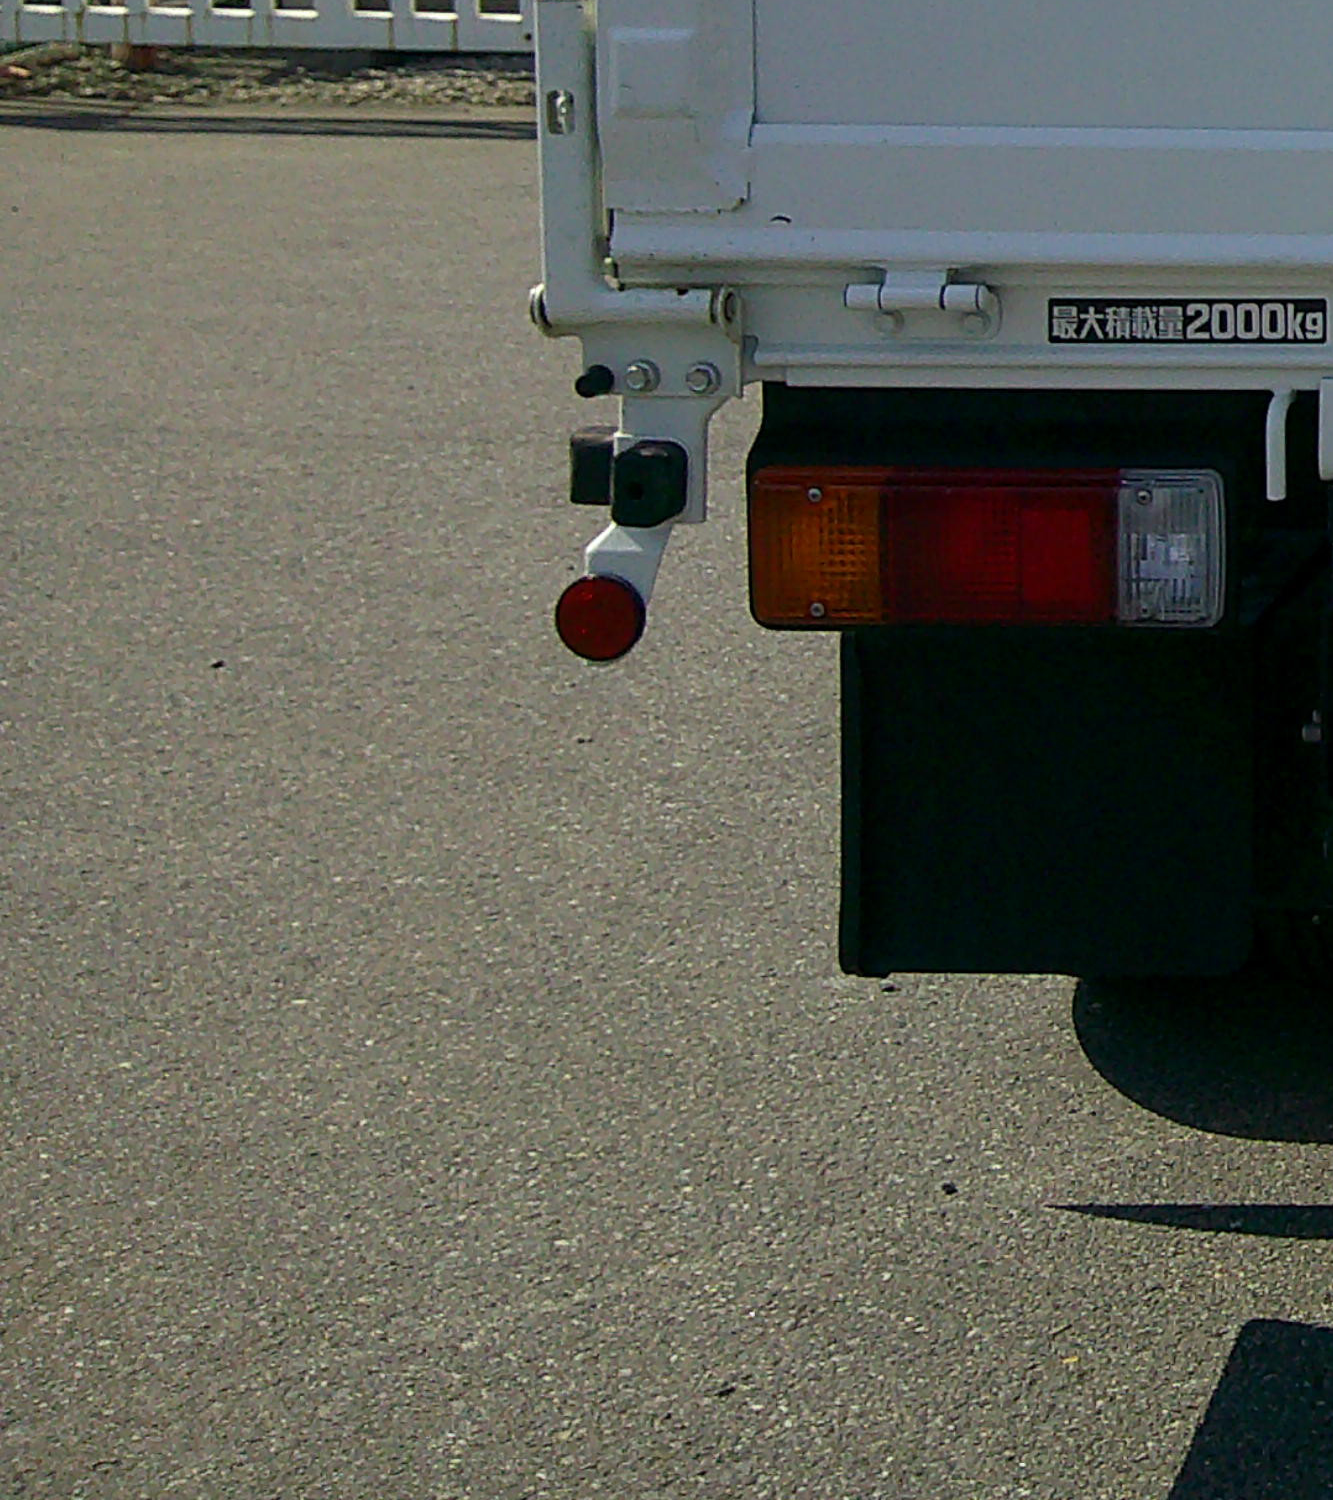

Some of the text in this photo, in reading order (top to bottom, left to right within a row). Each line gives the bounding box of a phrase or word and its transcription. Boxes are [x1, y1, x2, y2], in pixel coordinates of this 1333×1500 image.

[1051, 302, 1323, 340] 最大積載量2000kg
